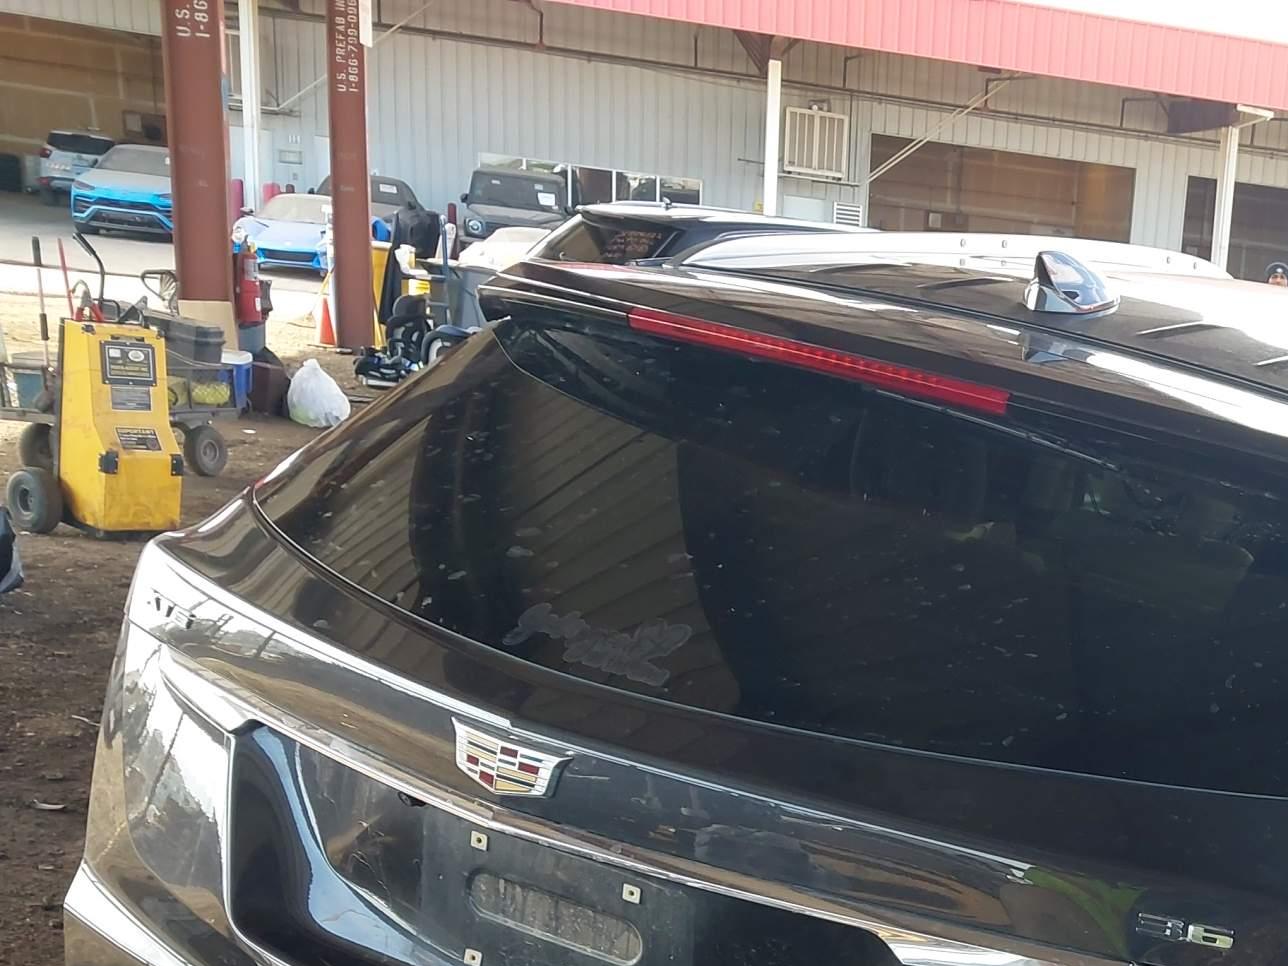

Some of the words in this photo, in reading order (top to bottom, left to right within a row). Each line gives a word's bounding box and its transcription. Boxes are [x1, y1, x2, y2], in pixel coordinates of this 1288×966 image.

[174, 3, 191, 37] U.S.
[335, 16, 347, 63] PREFAB
[336, 69, 347, 92] U.S.
